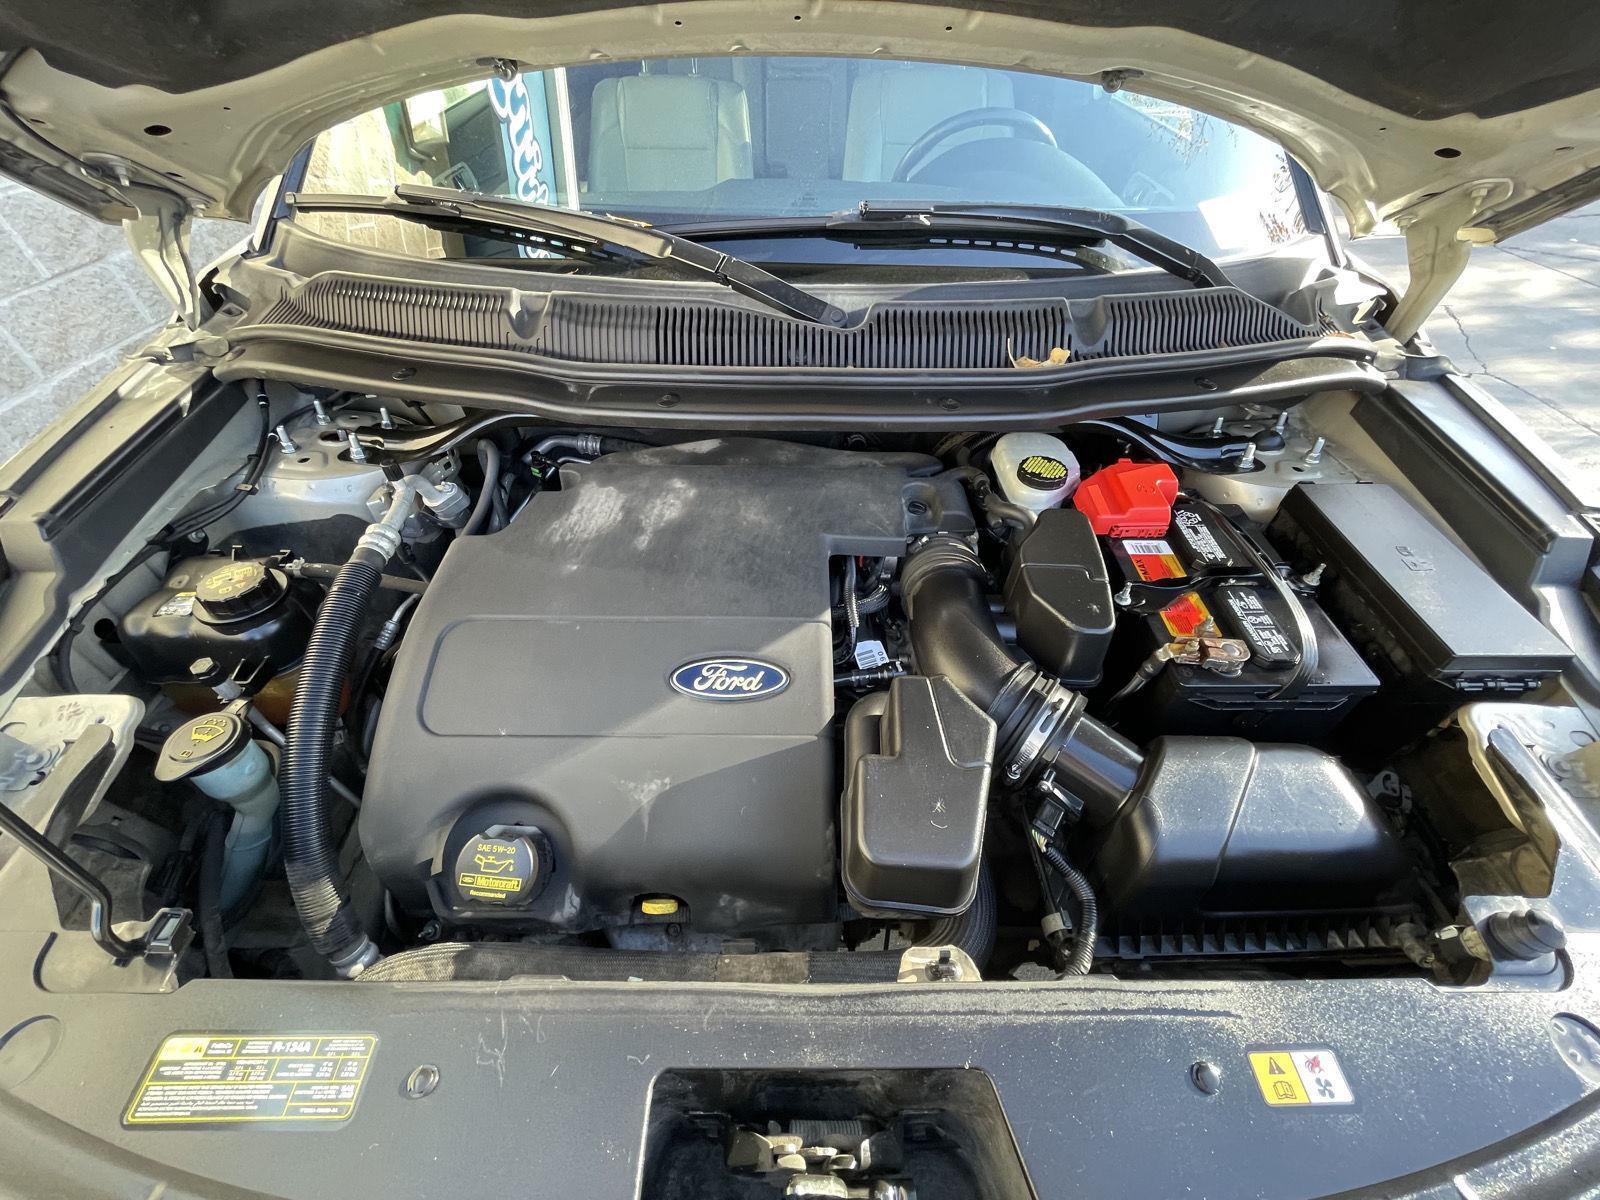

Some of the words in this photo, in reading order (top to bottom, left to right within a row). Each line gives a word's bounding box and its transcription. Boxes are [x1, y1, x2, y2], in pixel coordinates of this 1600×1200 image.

[693, 663, 765, 691] Ford
[477, 844, 491, 852] SAE
[493, 845, 516, 854] 5W-20
[477, 875, 519, 889] Motorcraft
[272, 1041, 311, 1053] R-134A
